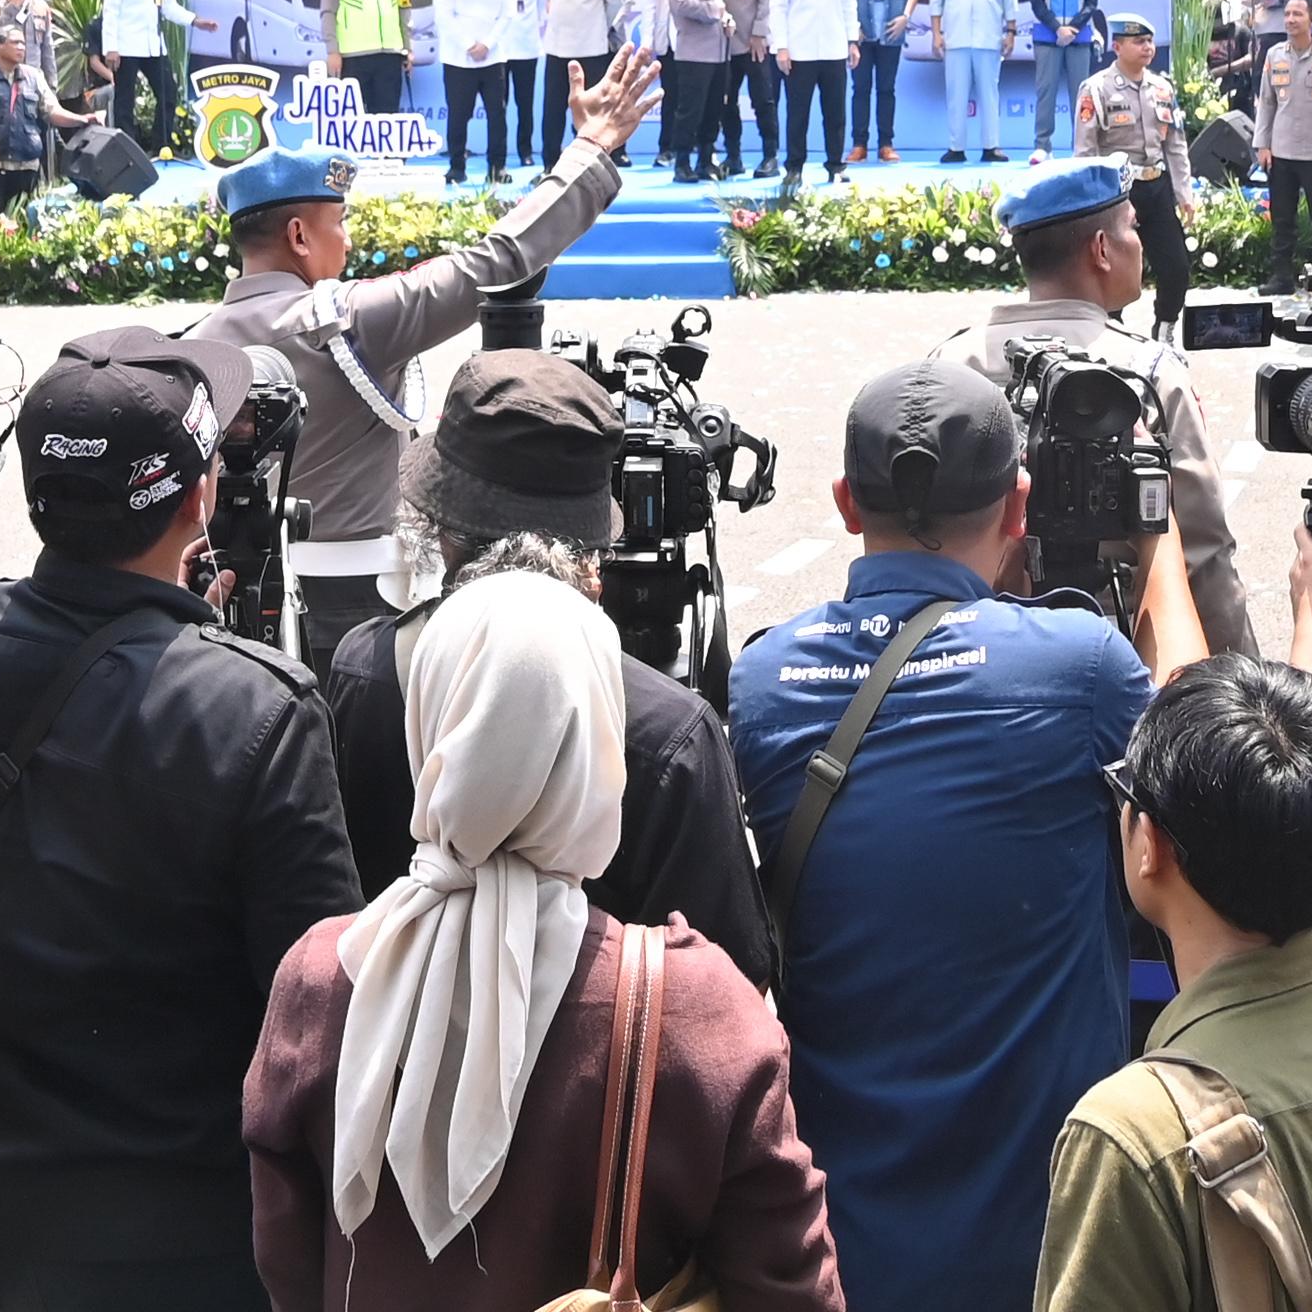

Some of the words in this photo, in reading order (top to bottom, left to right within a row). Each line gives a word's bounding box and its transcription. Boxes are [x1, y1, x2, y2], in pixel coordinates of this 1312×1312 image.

[201, 74, 240, 89] METRO
[240, 74, 268, 89] JAYA
[288, 81, 359, 118] JAGA
[40, 433, 108, 459] RACING
